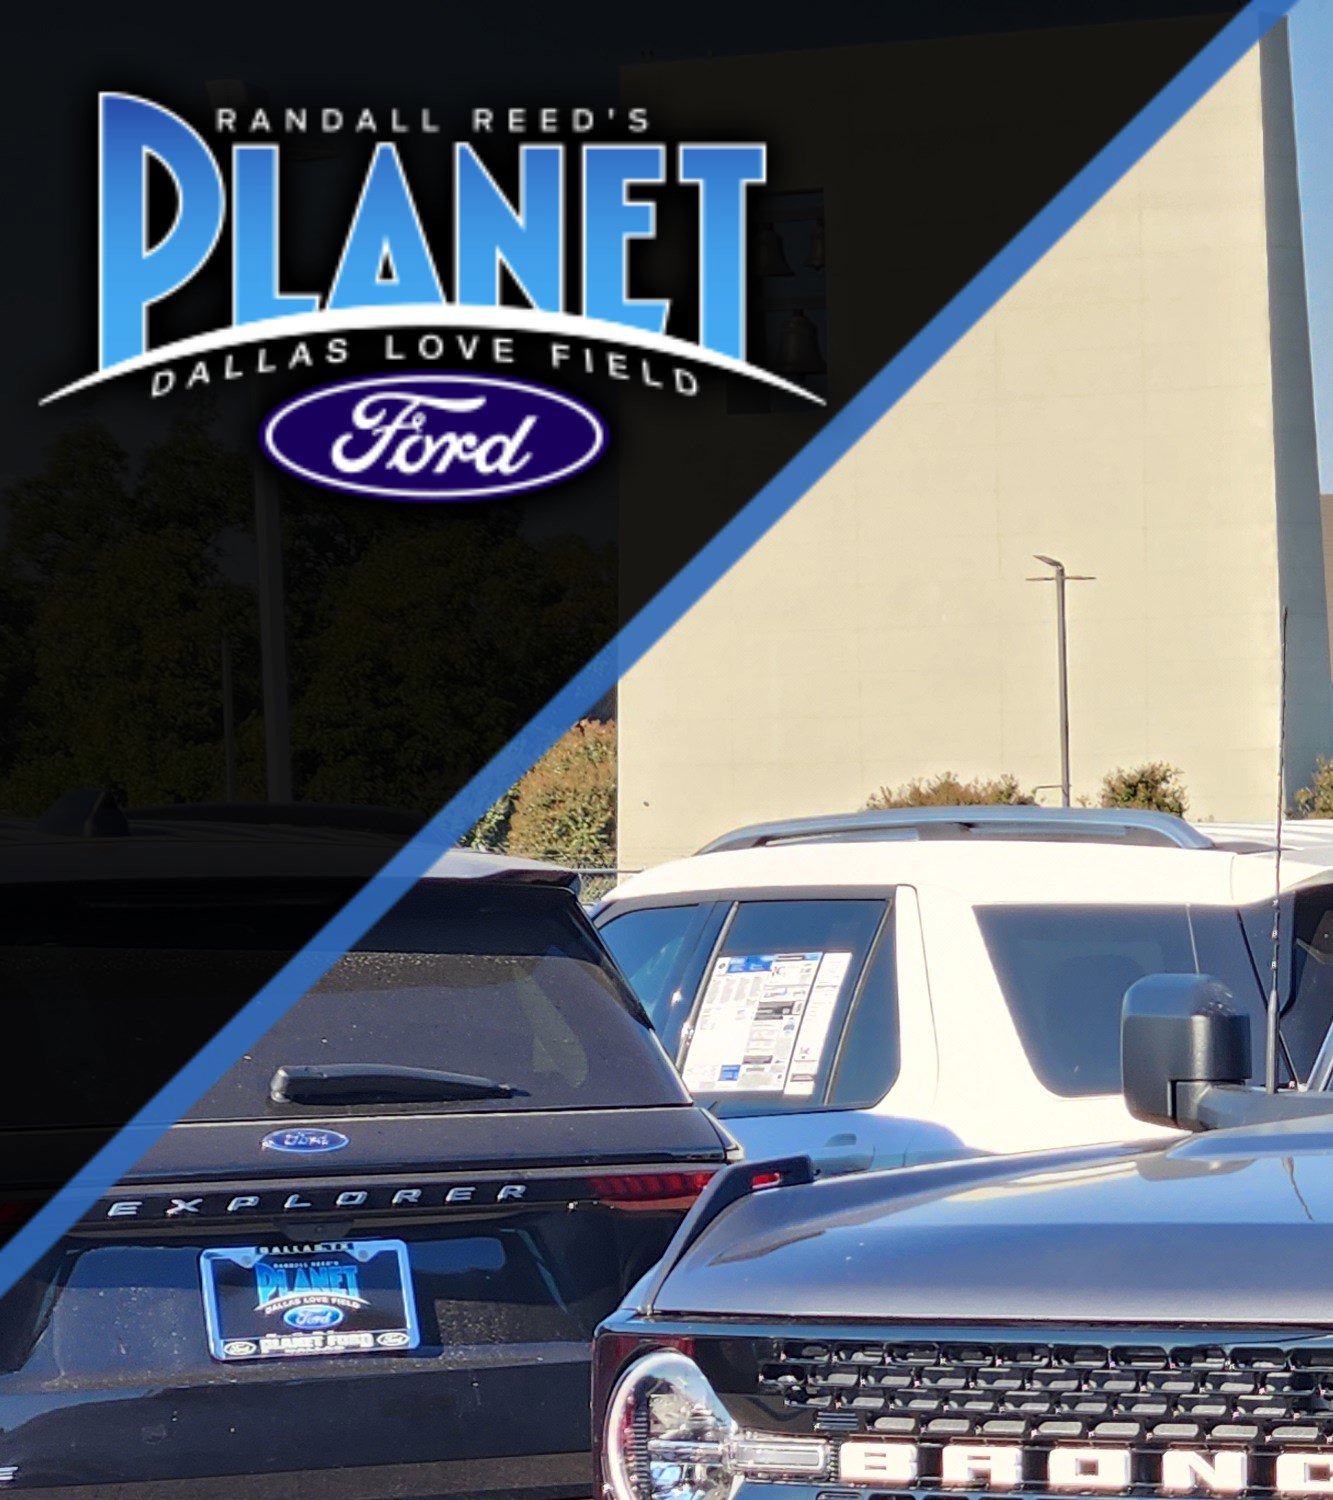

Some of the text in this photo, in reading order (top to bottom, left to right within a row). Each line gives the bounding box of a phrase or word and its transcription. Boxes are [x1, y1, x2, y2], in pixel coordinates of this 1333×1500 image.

[106, 1184, 529, 1218] EXPLORER
[255, 1262, 361, 1307] PLANET
[303, 1296, 329, 1305] LOVE
[331, 1297, 362, 1310] FIELD
[296, 1312, 332, 1327] Ford
